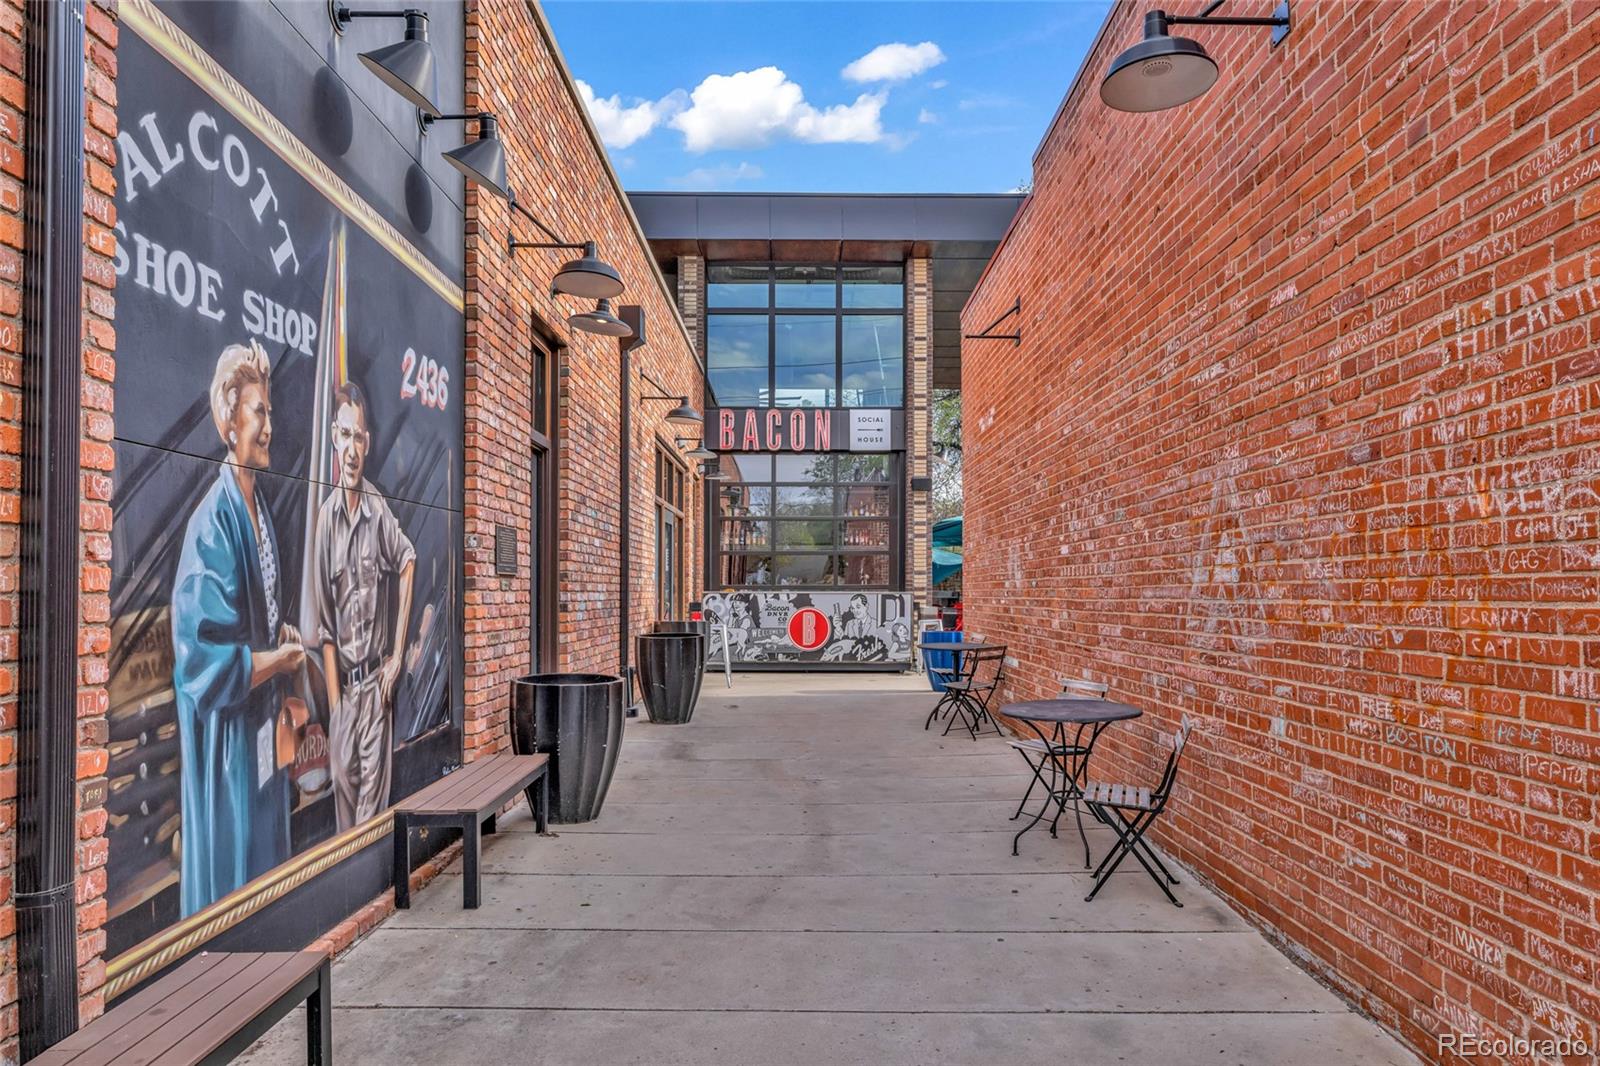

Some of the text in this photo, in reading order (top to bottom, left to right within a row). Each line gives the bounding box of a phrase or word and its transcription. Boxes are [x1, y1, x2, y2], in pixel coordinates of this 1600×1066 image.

[114, 220, 317, 356] SHOE SHOP
[400, 347, 449, 411] 2436
[719, 408, 831, 451] BACON
[765, 603, 790, 611] Bacon
[802, 611, 816, 646] B
[1472, 637, 1512, 660] CAT
[1385, 724, 1457, 760] BOSTON
[1455, 926, 1503, 964] MAYRA
